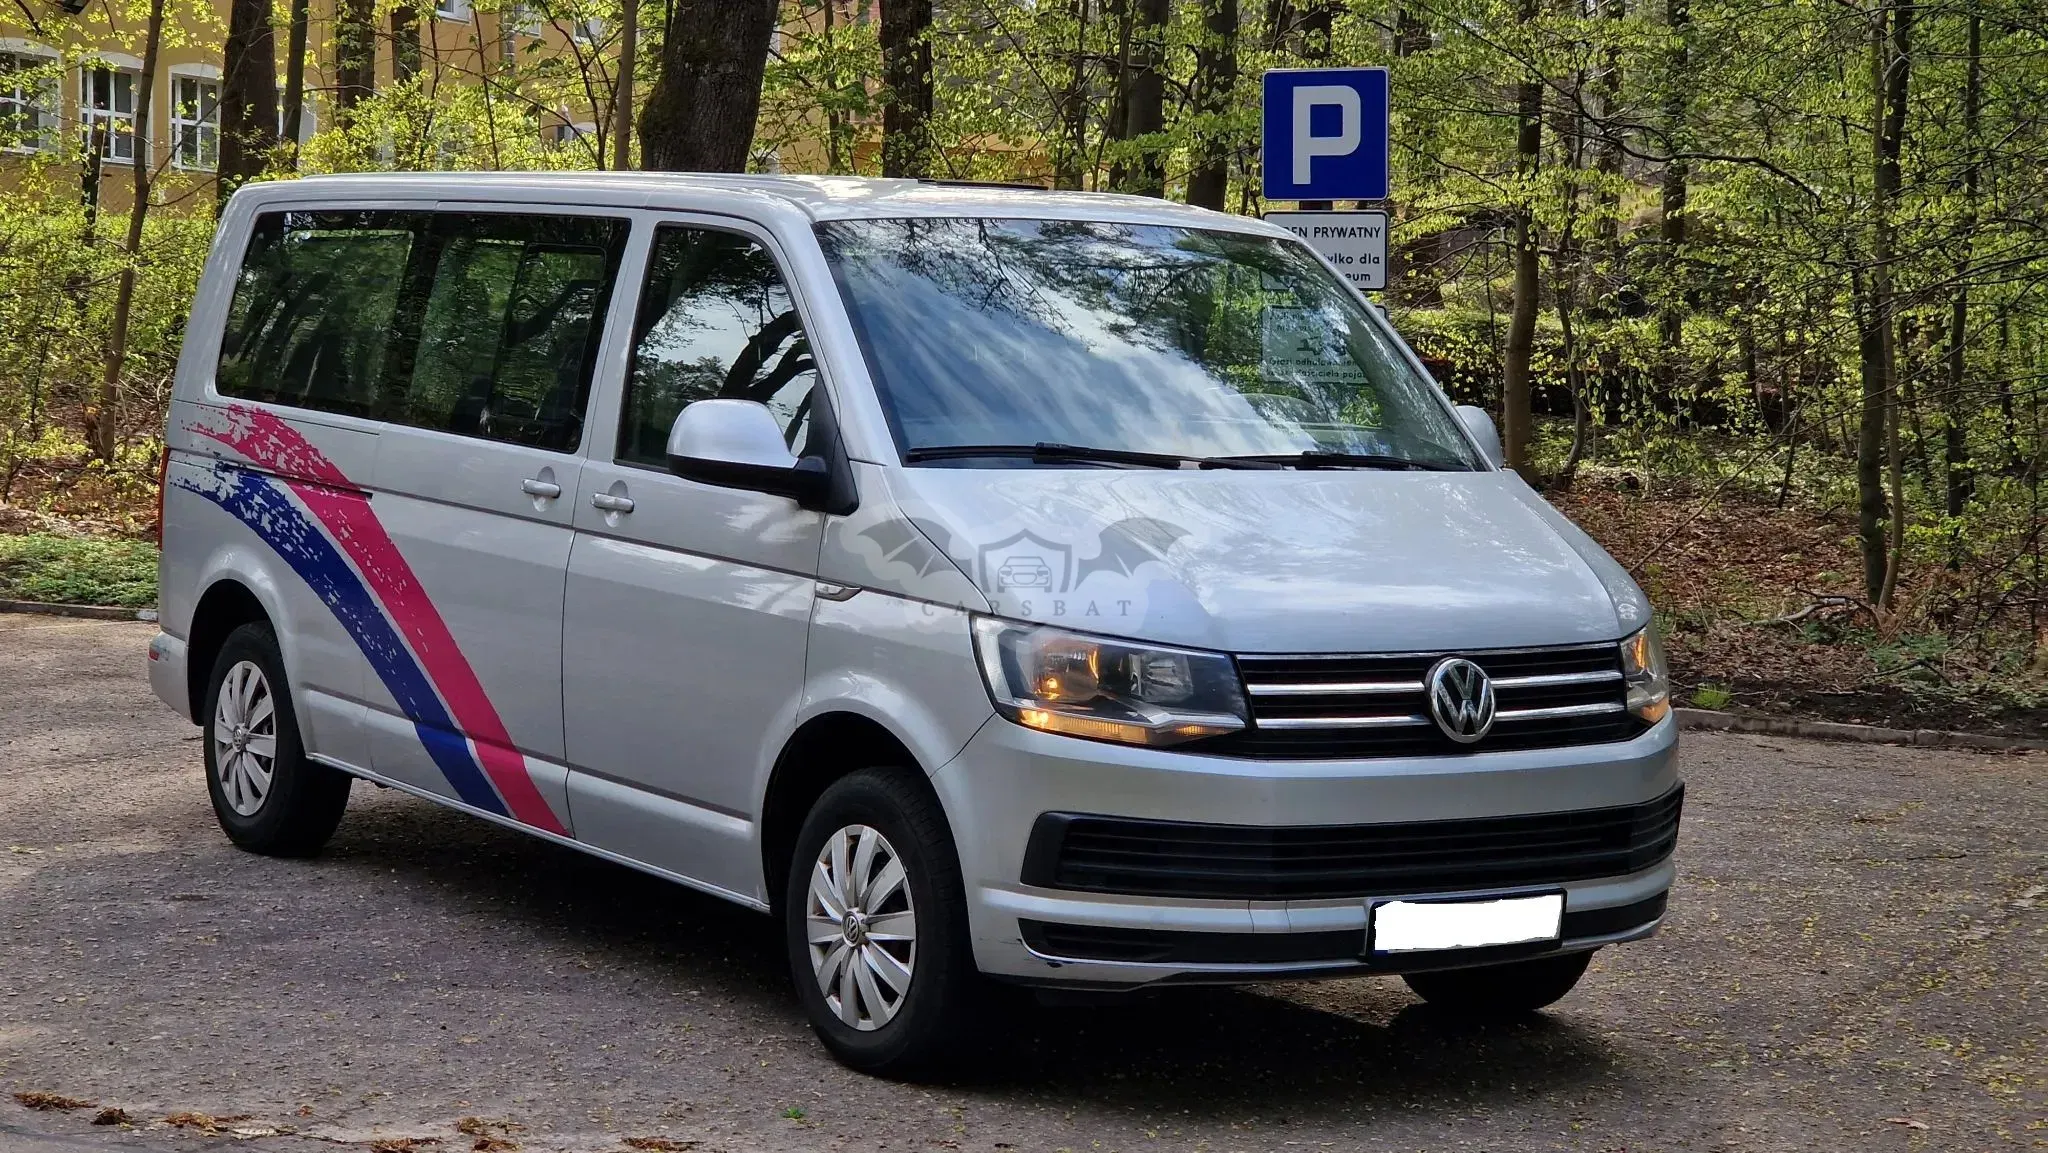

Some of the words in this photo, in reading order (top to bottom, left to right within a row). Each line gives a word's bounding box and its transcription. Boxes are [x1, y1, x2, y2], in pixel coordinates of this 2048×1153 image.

[1292, 85, 1361, 185] P
[1313, 226, 1381, 238] PRYWATNY
[1323, 252, 1354, 264] ylko
[1359, 252, 1380, 264] dla
[1345, 273, 1371, 282] eum
